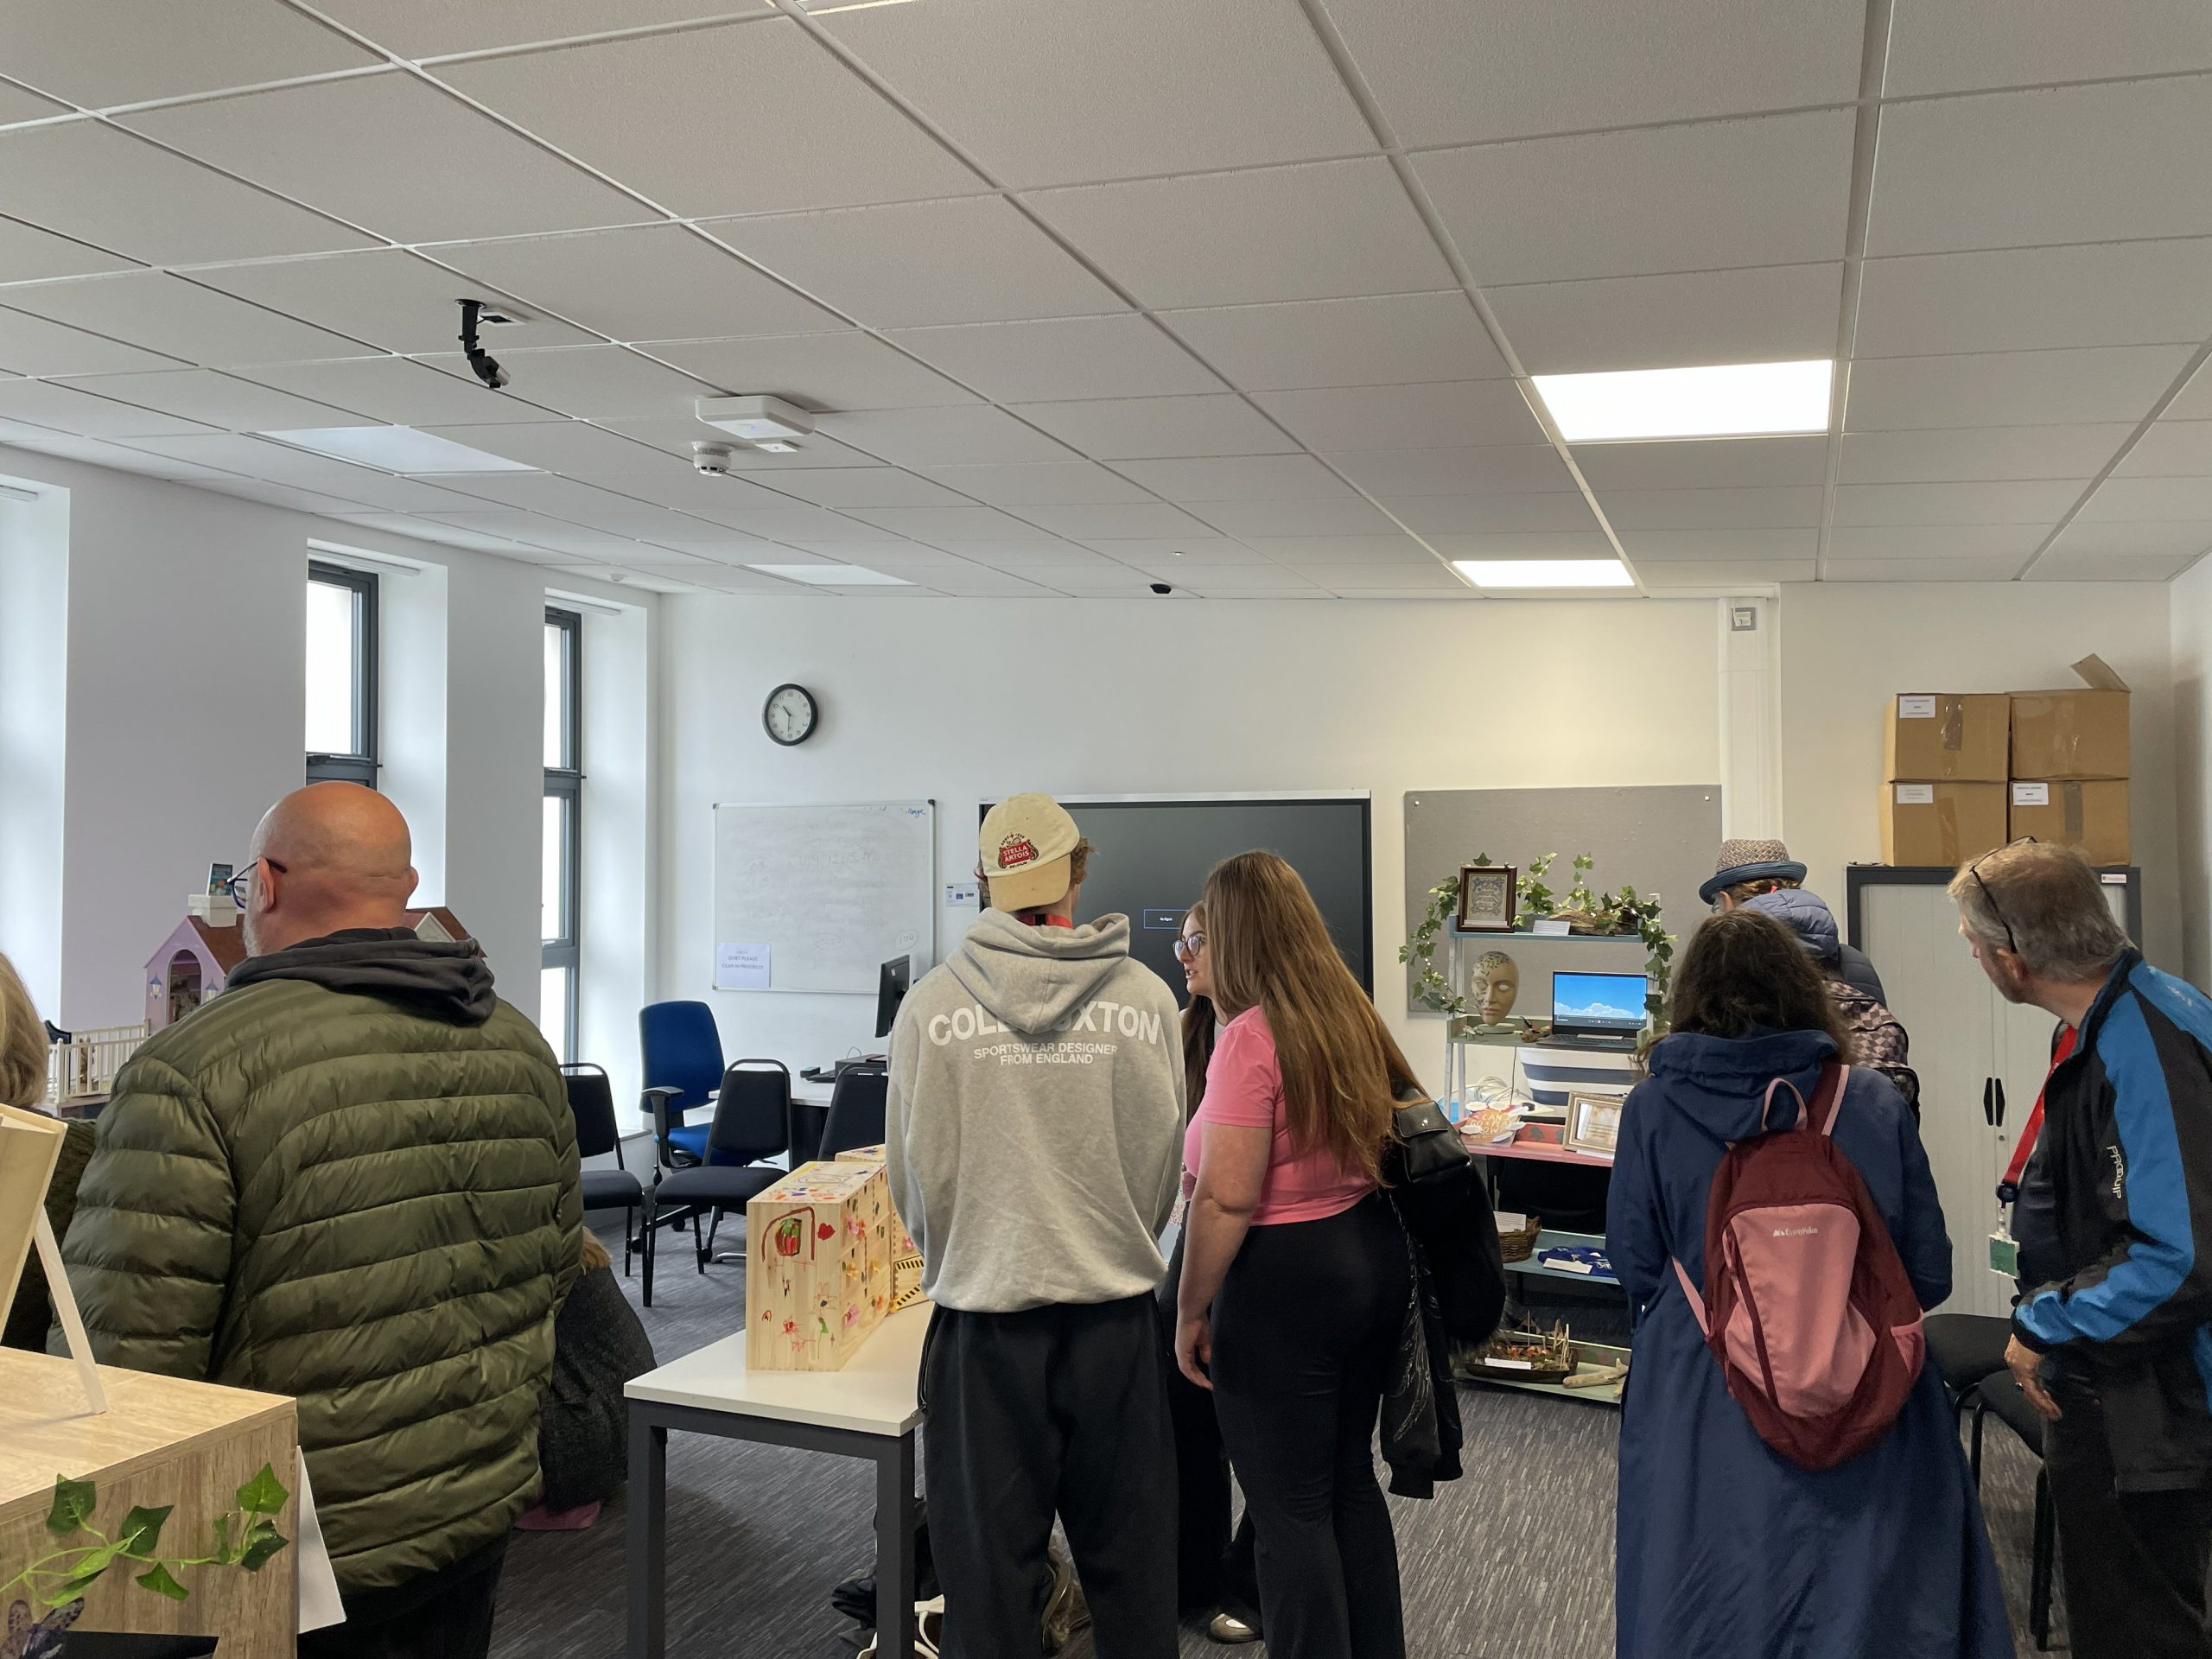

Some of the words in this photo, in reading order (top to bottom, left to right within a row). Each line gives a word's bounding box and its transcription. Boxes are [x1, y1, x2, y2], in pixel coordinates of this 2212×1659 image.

[1003, 845, 1028, 856] STELLA
[1004, 850, 1030, 862] ARTOIS
[974, 1042, 1055, 1059] SPORTSWEAR
[1058, 1042, 1118, 1055] DESIGNER
[1000, 1054, 1033, 1065] FROM
[1036, 1053, 1094, 1065] ENGLAND
